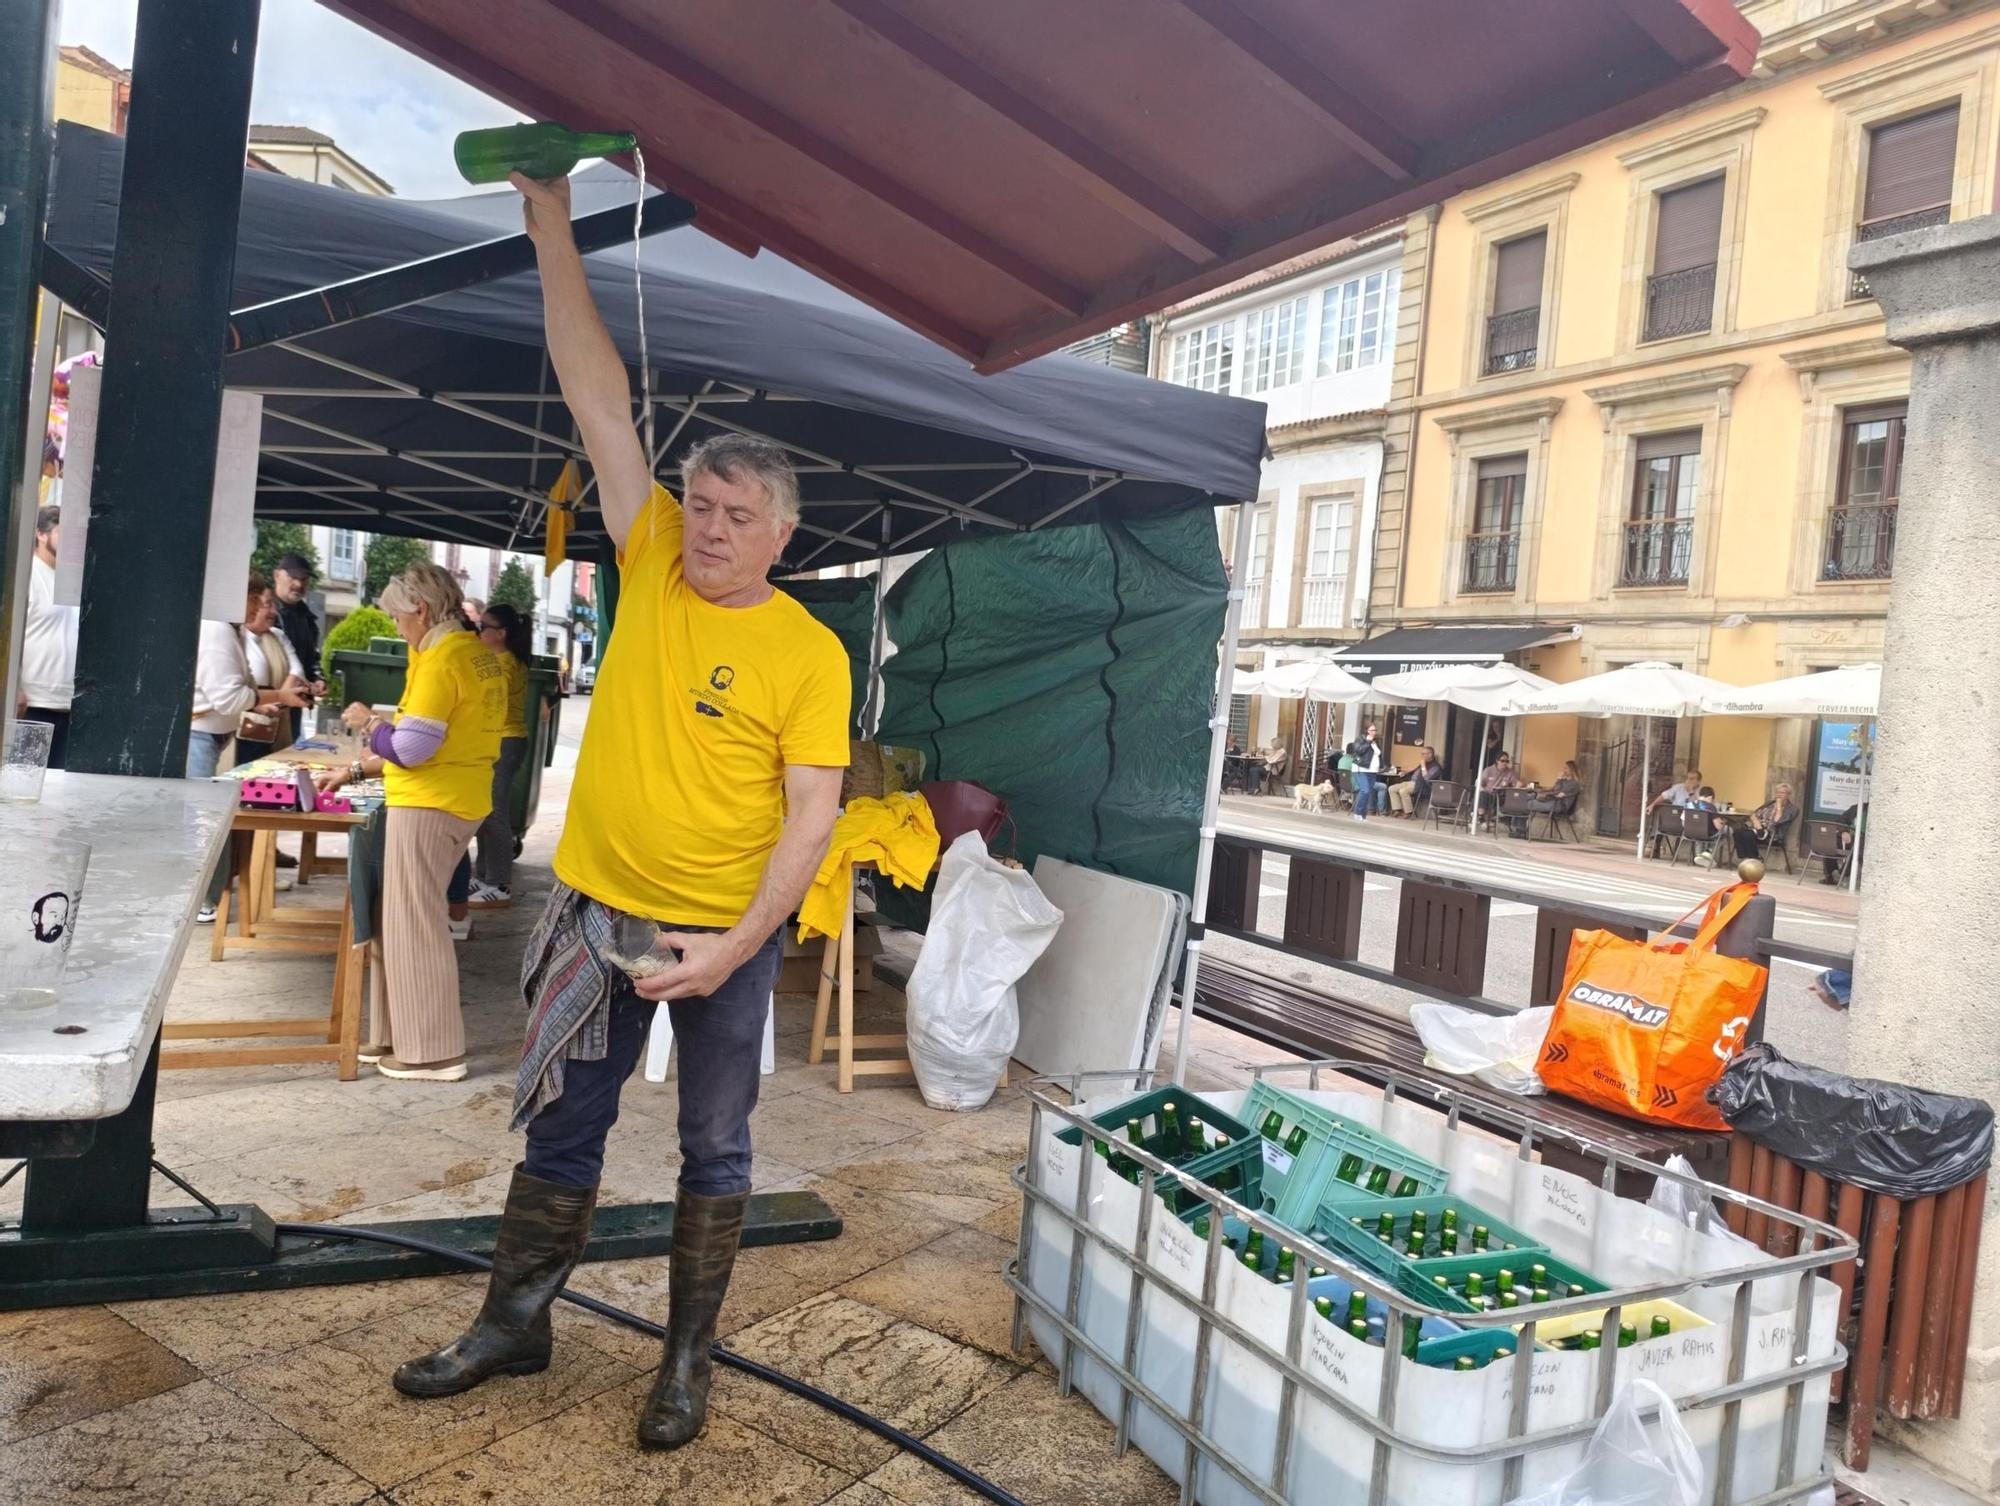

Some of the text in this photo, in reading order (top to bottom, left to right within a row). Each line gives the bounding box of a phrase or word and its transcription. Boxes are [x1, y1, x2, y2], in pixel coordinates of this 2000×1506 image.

[1724, 702, 1764, 711] Alhambra
[1817, 704, 1848, 713] CERVEZA
[1573, 986, 1668, 1025] OBRAMAT
[1638, 1346, 1674, 1372] JAVIER
